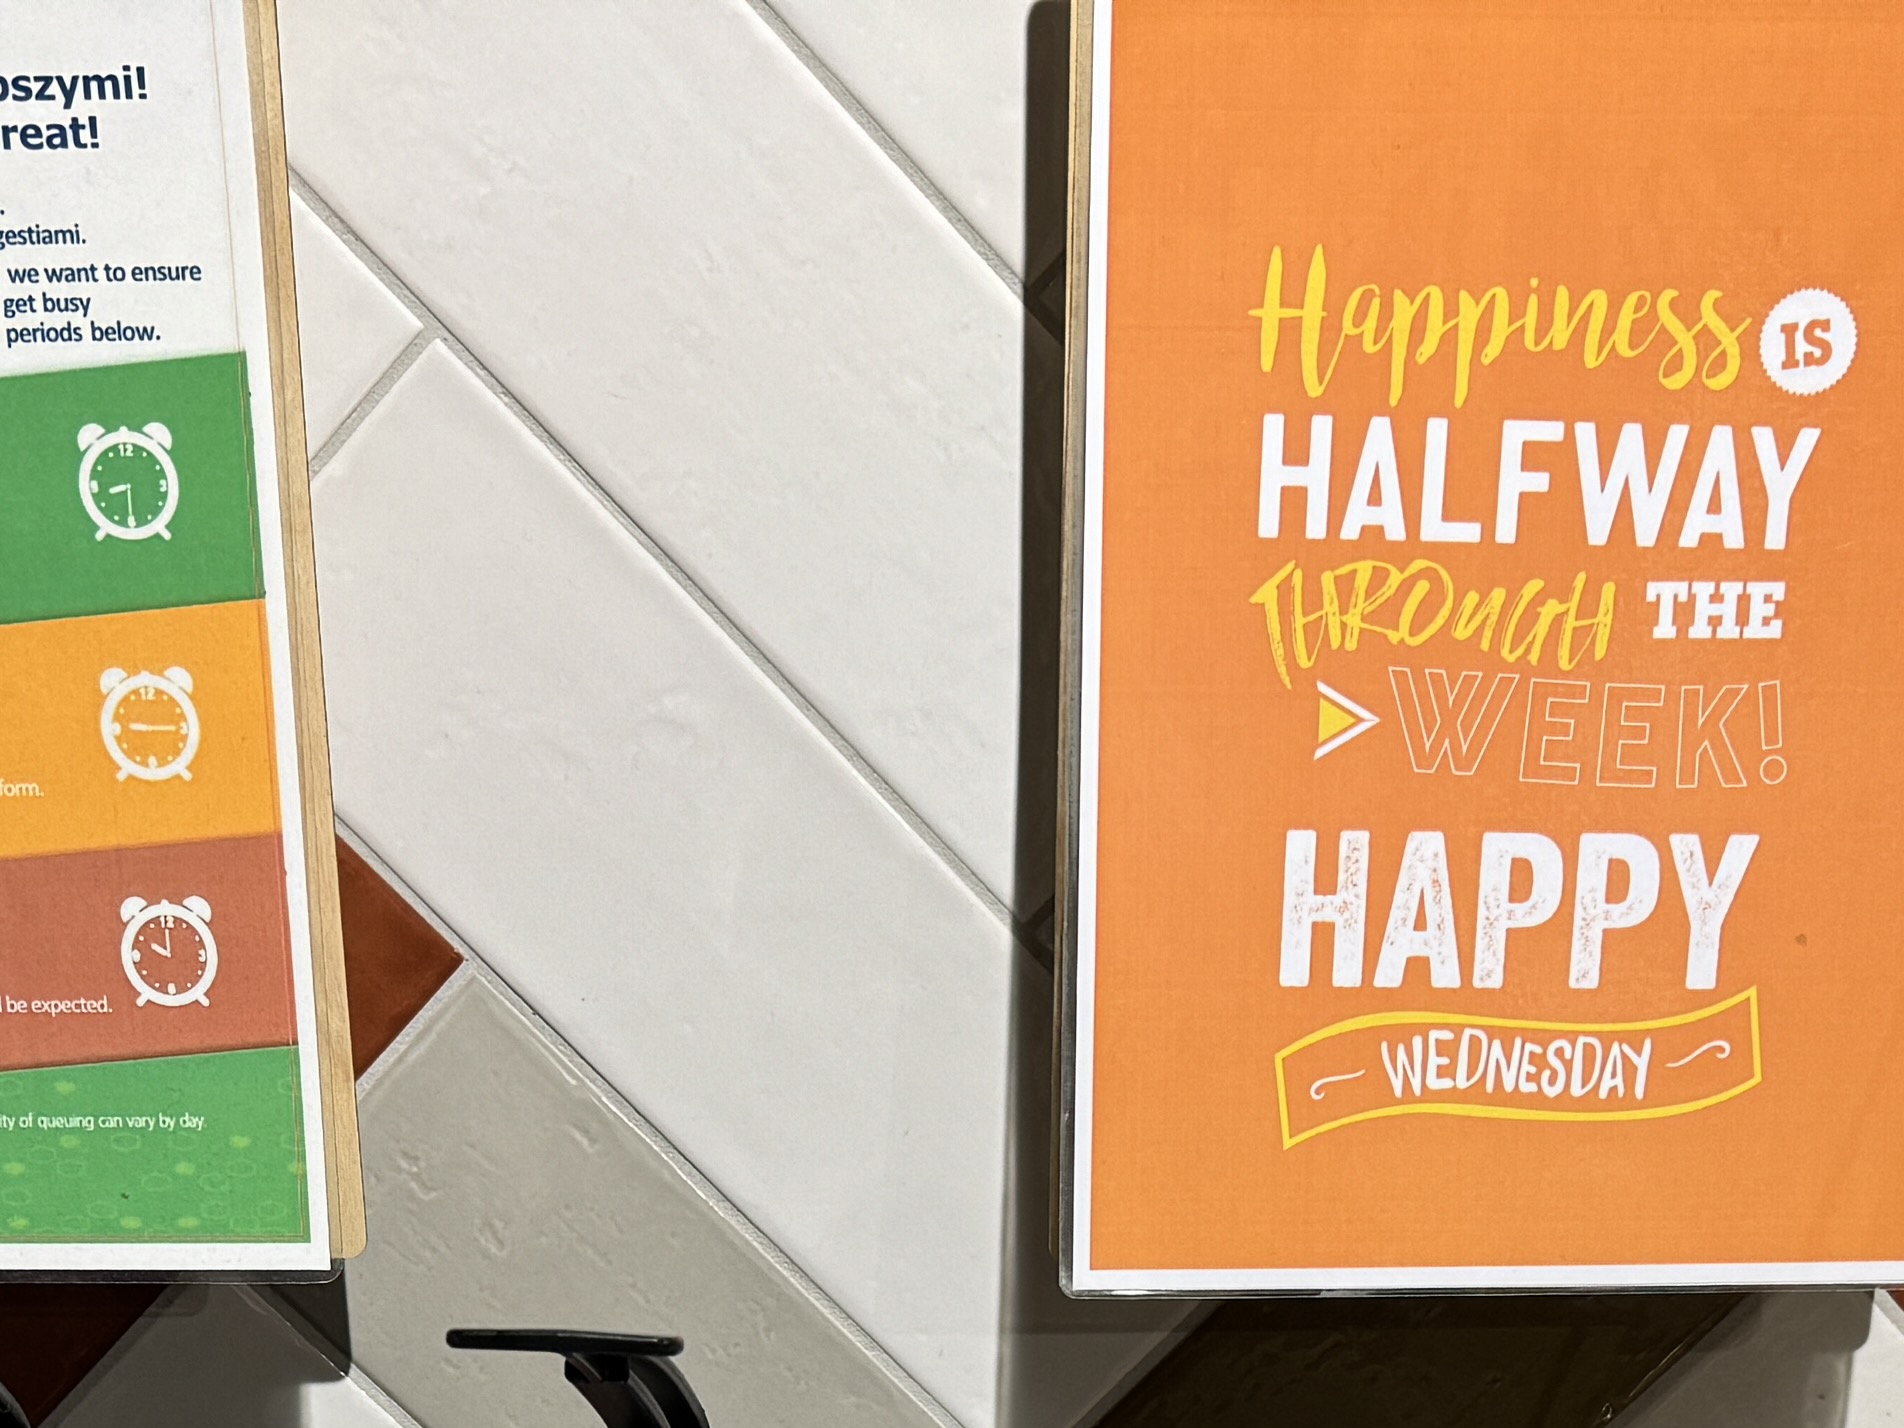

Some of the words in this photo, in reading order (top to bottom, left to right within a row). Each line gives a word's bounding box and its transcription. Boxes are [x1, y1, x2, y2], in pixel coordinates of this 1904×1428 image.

[7, 268, 39, 284] we
[43, 263, 99, 283] want
[103, 263, 126, 282] to
[131, 265, 202, 282] ensure
[6, 322, 83, 349] periods
[90, 321, 161, 341] below.
[1248, 244, 1750, 408] Happiness
[1780, 317, 1833, 371] IS
[1257, 413, 1821, 550] HALFWAY
[1646, 580, 1784, 639] THE
[1388, 666, 1787, 788] WEEK!
[1279, 829, 1760, 989] HAPPY
[5, 995, 27, 1013] be
[31, 995, 113, 1017] expected.
[1380, 1027, 1652, 1099] WEDNESDAY
